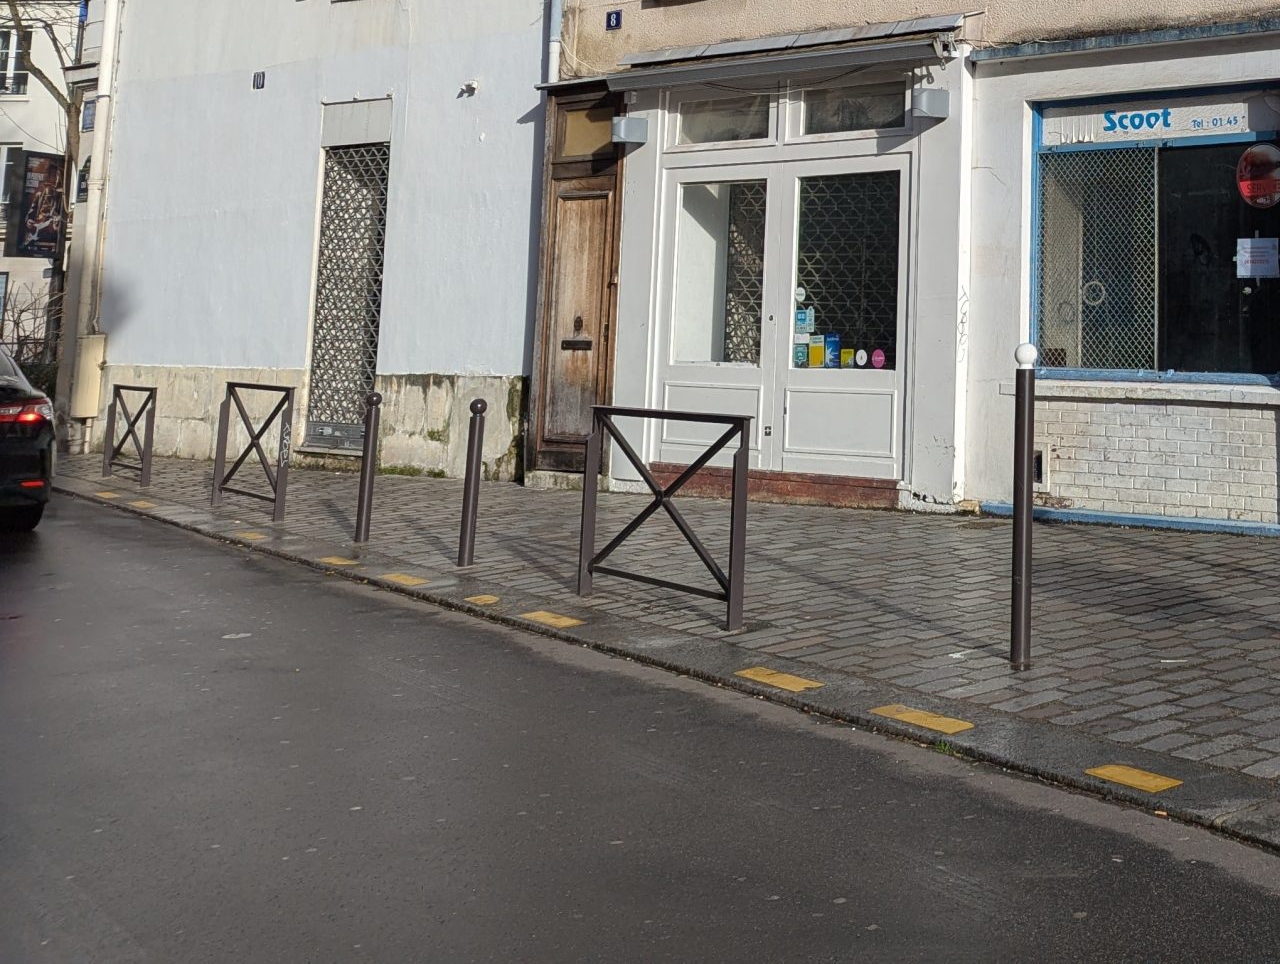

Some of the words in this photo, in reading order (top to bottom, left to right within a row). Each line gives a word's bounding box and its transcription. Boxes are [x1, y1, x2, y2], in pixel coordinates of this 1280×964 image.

[610, 13, 617, 27] 8
[1103, 107, 1172, 132] Scoot
[1212, 117, 1224, 127] 01
[1226, 116, 1238, 126] 45
